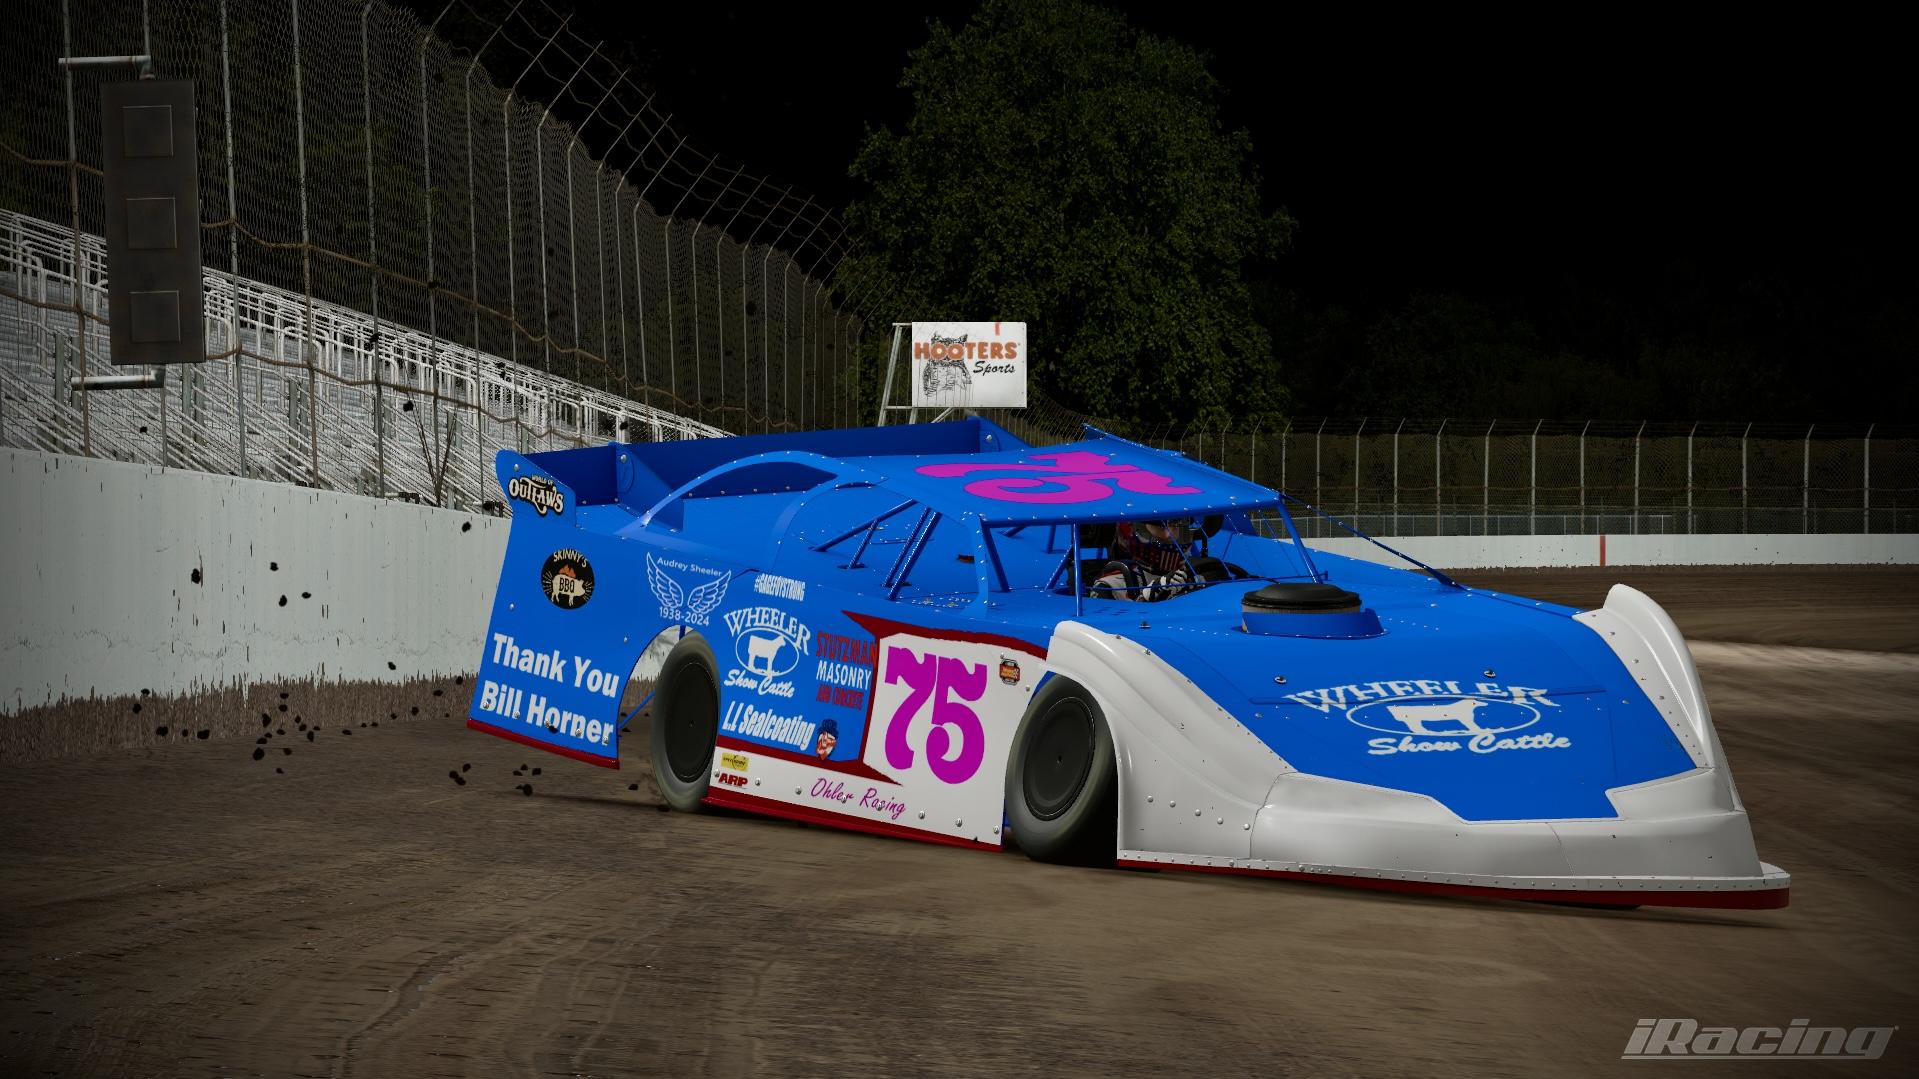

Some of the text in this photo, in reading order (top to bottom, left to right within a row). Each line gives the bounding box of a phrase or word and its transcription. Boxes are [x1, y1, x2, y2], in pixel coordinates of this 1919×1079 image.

[914, 342, 1017, 360] HOOTERS
[973, 361, 1015, 376] Sports
[553, 548, 588, 568] SKINNY'S
[657, 557, 722, 577] Audrey Sheeler
[559, 577, 575, 594] BBQ
[659, 606, 710, 626] 1938-2024
[723, 606, 811, 656] WHEELER
[816, 630, 878, 667] STUTZMAN
[493, 632, 620, 698] Thank You
[816, 660, 872, 690] MASONRY
[724, 669, 795, 698] Show Cattle
[1282, 680, 1560, 713] WHEELER
[480, 680, 614, 746] Bill Horner
[738, 704, 816, 751] Sealcoating
[885, 646, 987, 784] 75
[1367, 732, 1572, 755] Show Cattle
[718, 772, 748, 787] ARP
[811, 777, 906, 820] Ohler Racing
